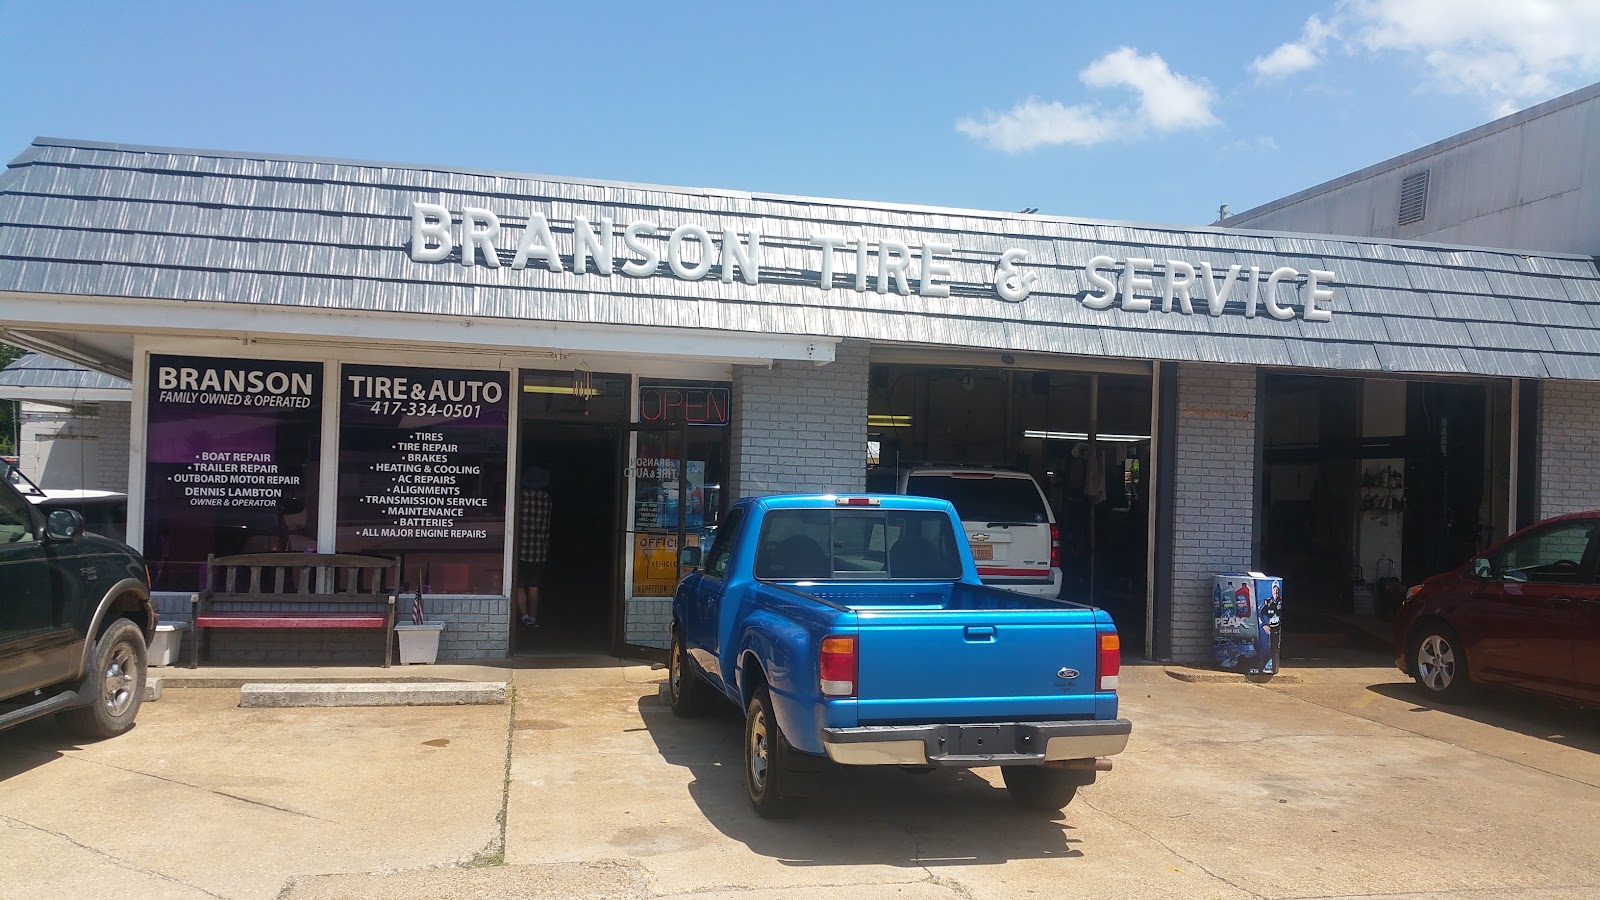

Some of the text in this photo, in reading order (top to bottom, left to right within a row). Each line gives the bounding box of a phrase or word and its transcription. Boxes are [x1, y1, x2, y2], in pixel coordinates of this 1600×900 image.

[411, 202, 1335, 322] BRANSON TIRE & SERVICE
[159, 367, 312, 395] BRANSON
[159, 391, 311, 408] FAMILY OWNED & OPERATED
[371, 402, 482, 418] 417-334-0501
[642, 389, 726, 421] OPEN
[415, 432, 444, 441] TIRES
[398, 443, 458, 452] TIRE REPAIR
[202, 452, 271, 462] BOAT REPAIR
[408, 454, 447, 462] BRAKES
[194, 463, 278, 473] TRAILER REPAIR
[376, 464, 480, 474] HEATING & COOLING
[174, 474, 300, 485] OUTBOARD MOTOR REPAIR
[398, 475, 456, 484] AC REPAIRS
[185, 487, 282, 497] DENNIS LAMBTON
[393, 485, 460, 495] ALIGNMENTS
[190, 498, 222, 506] OWNER
[231, 498, 276, 507] OPERATOR
[366, 496, 488, 506] TRANSMISSION SERVICE
[388, 507, 464, 516] MAINTENANCE
[400, 518, 454, 527] BATTERIES
[362, 528, 487, 538] ALL MAJOR ENGINE REPAIRS
[634, 584, 667, 594] INSPECTION
[1214, 617, 1250, 629] PEAK
